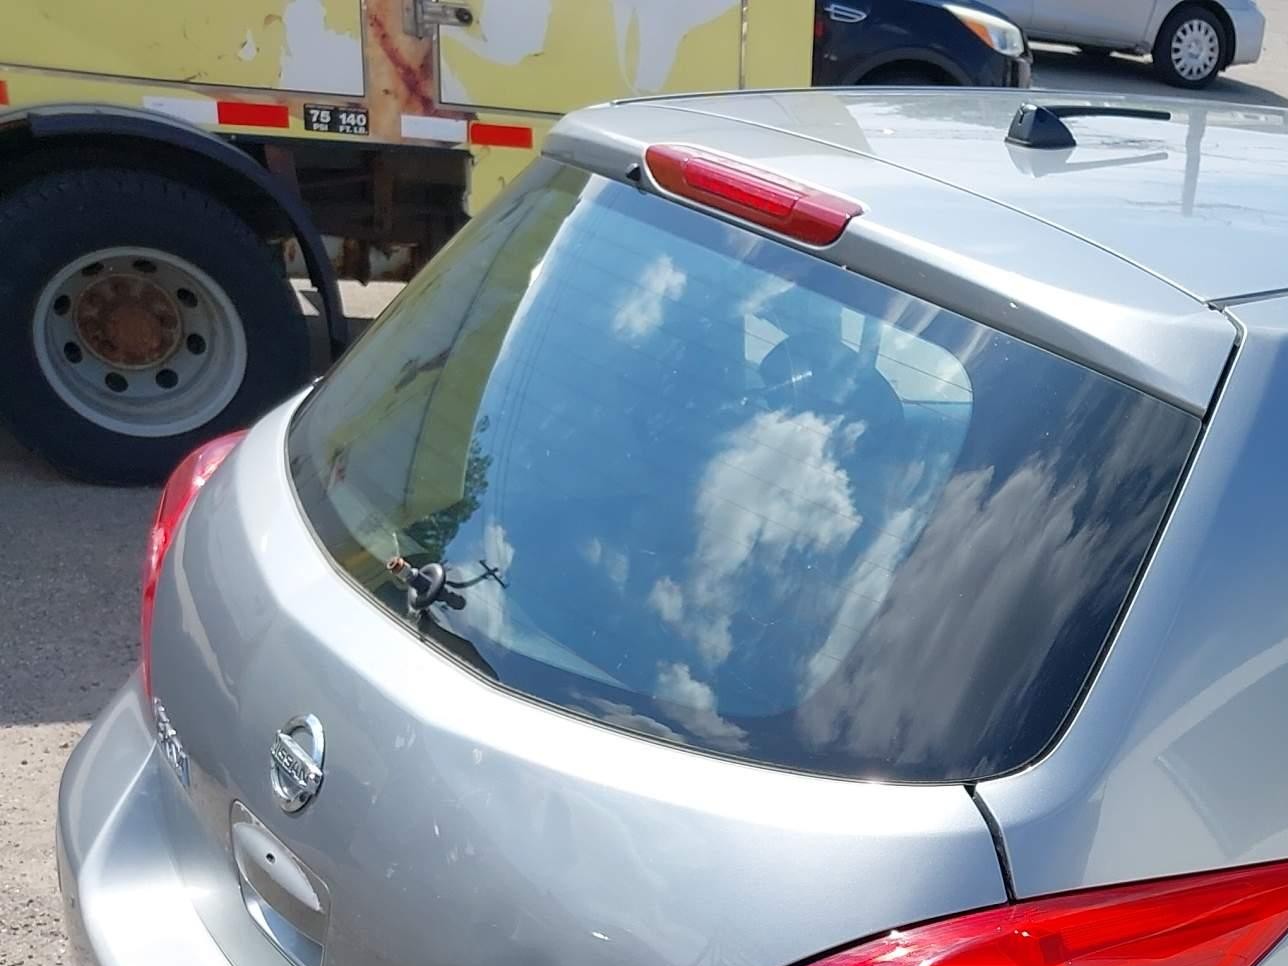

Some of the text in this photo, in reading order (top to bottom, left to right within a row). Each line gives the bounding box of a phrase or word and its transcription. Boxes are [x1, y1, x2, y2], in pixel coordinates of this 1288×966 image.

[309, 109, 331, 123] 75
[339, 112, 367, 126] 140
[271, 732, 311, 787] NISSAN
